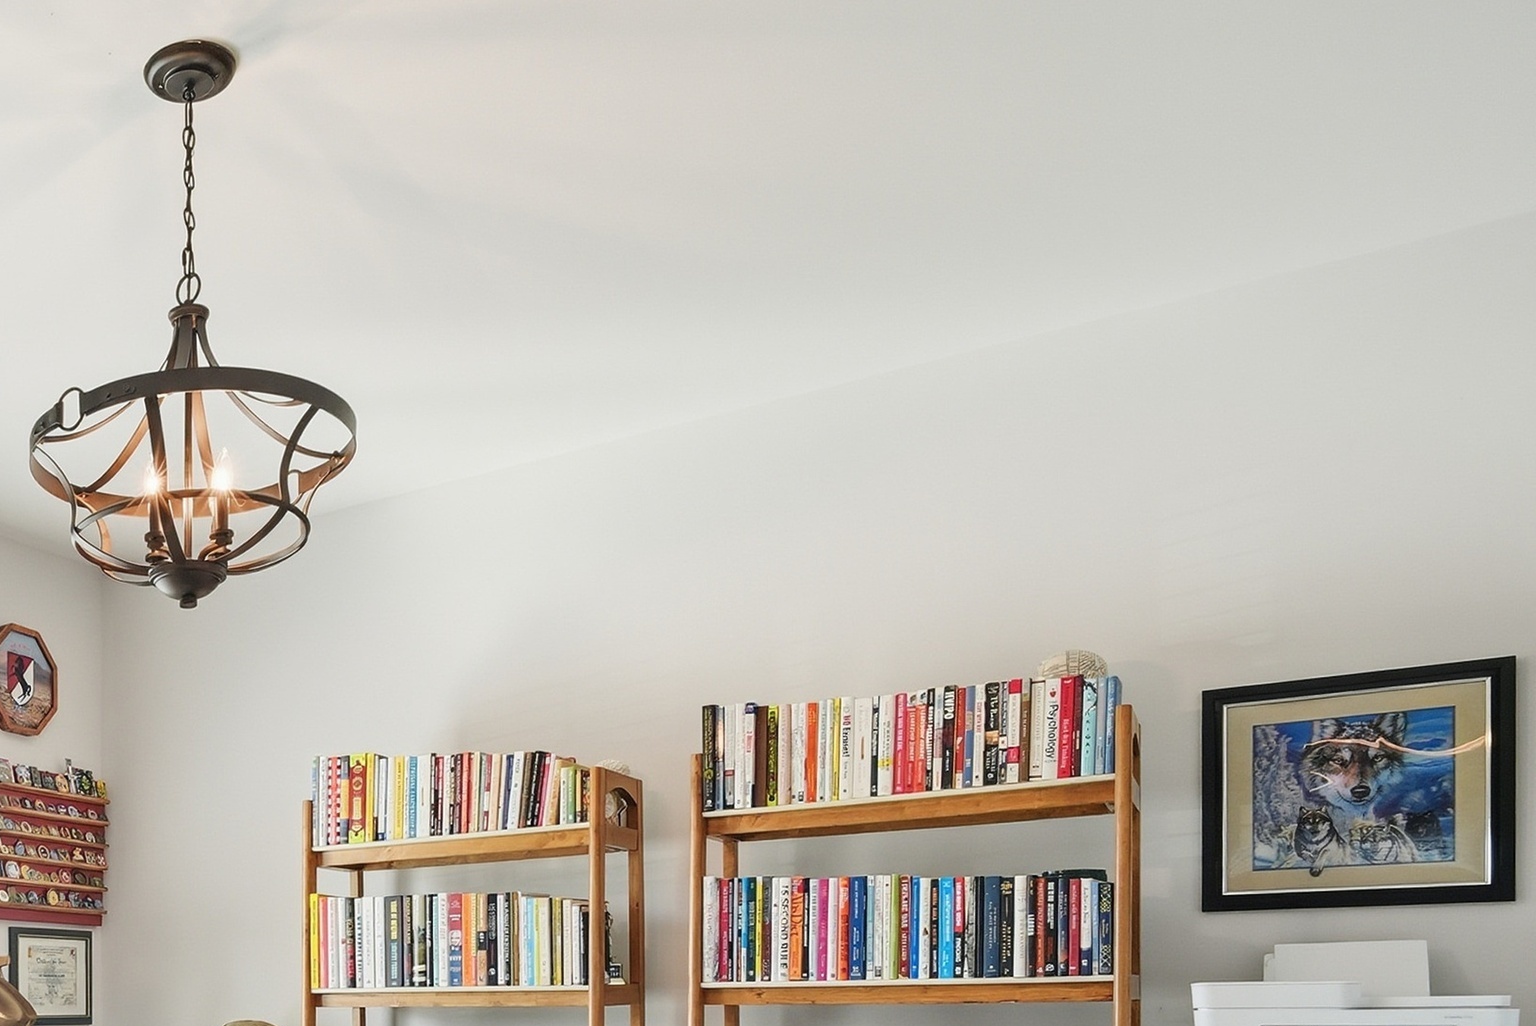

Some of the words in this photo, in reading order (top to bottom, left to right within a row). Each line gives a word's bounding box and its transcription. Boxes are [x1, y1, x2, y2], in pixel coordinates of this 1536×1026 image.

[1045, 704, 1059, 759] Psychology
[780, 898, 789, 941] SECOND
[780, 942, 789, 969] RULE
